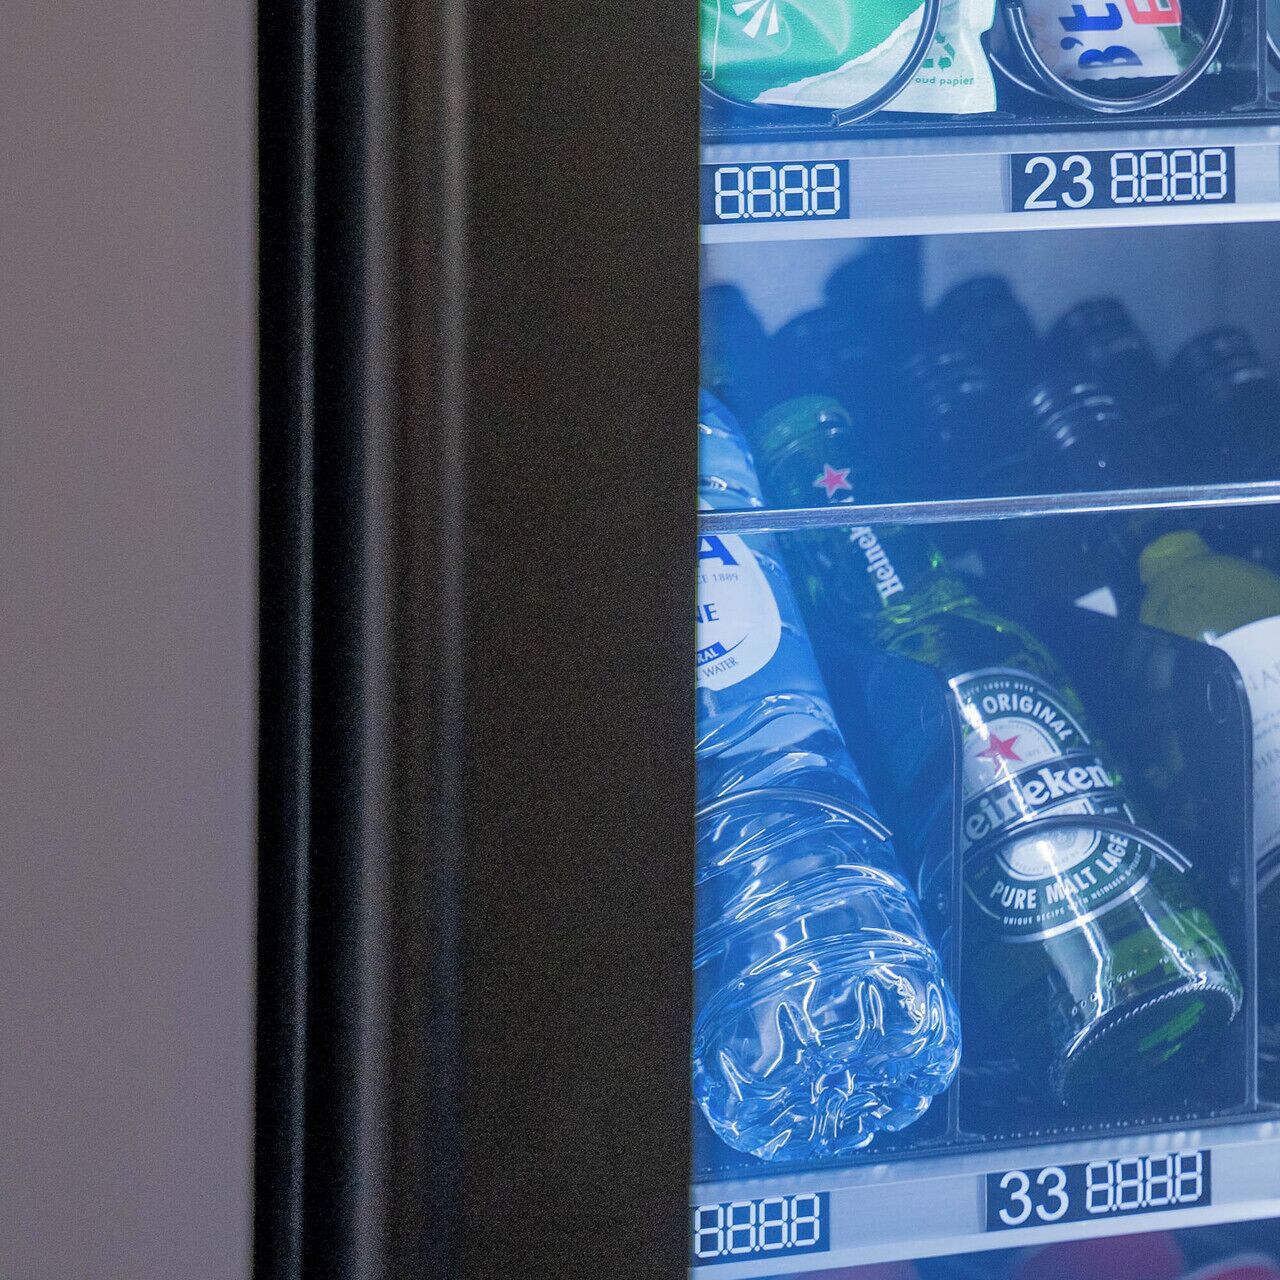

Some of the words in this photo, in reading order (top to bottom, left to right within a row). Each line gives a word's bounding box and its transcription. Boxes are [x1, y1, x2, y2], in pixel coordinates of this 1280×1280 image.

[915, 76, 935, 85] oud
[940, 77, 974, 88] papier
[1022, 155, 1096, 210] 23
[703, 657, 738, 678] WATER
[982, 693, 1073, 741] ORIGINAL
[964, 762, 1113, 840] eineken
[990, 880, 1037, 910] PURE
[1045, 866, 1098, 904] MALT
[1095, 834, 1128, 875] LAGE
[999, 1166, 1070, 1227] 33
